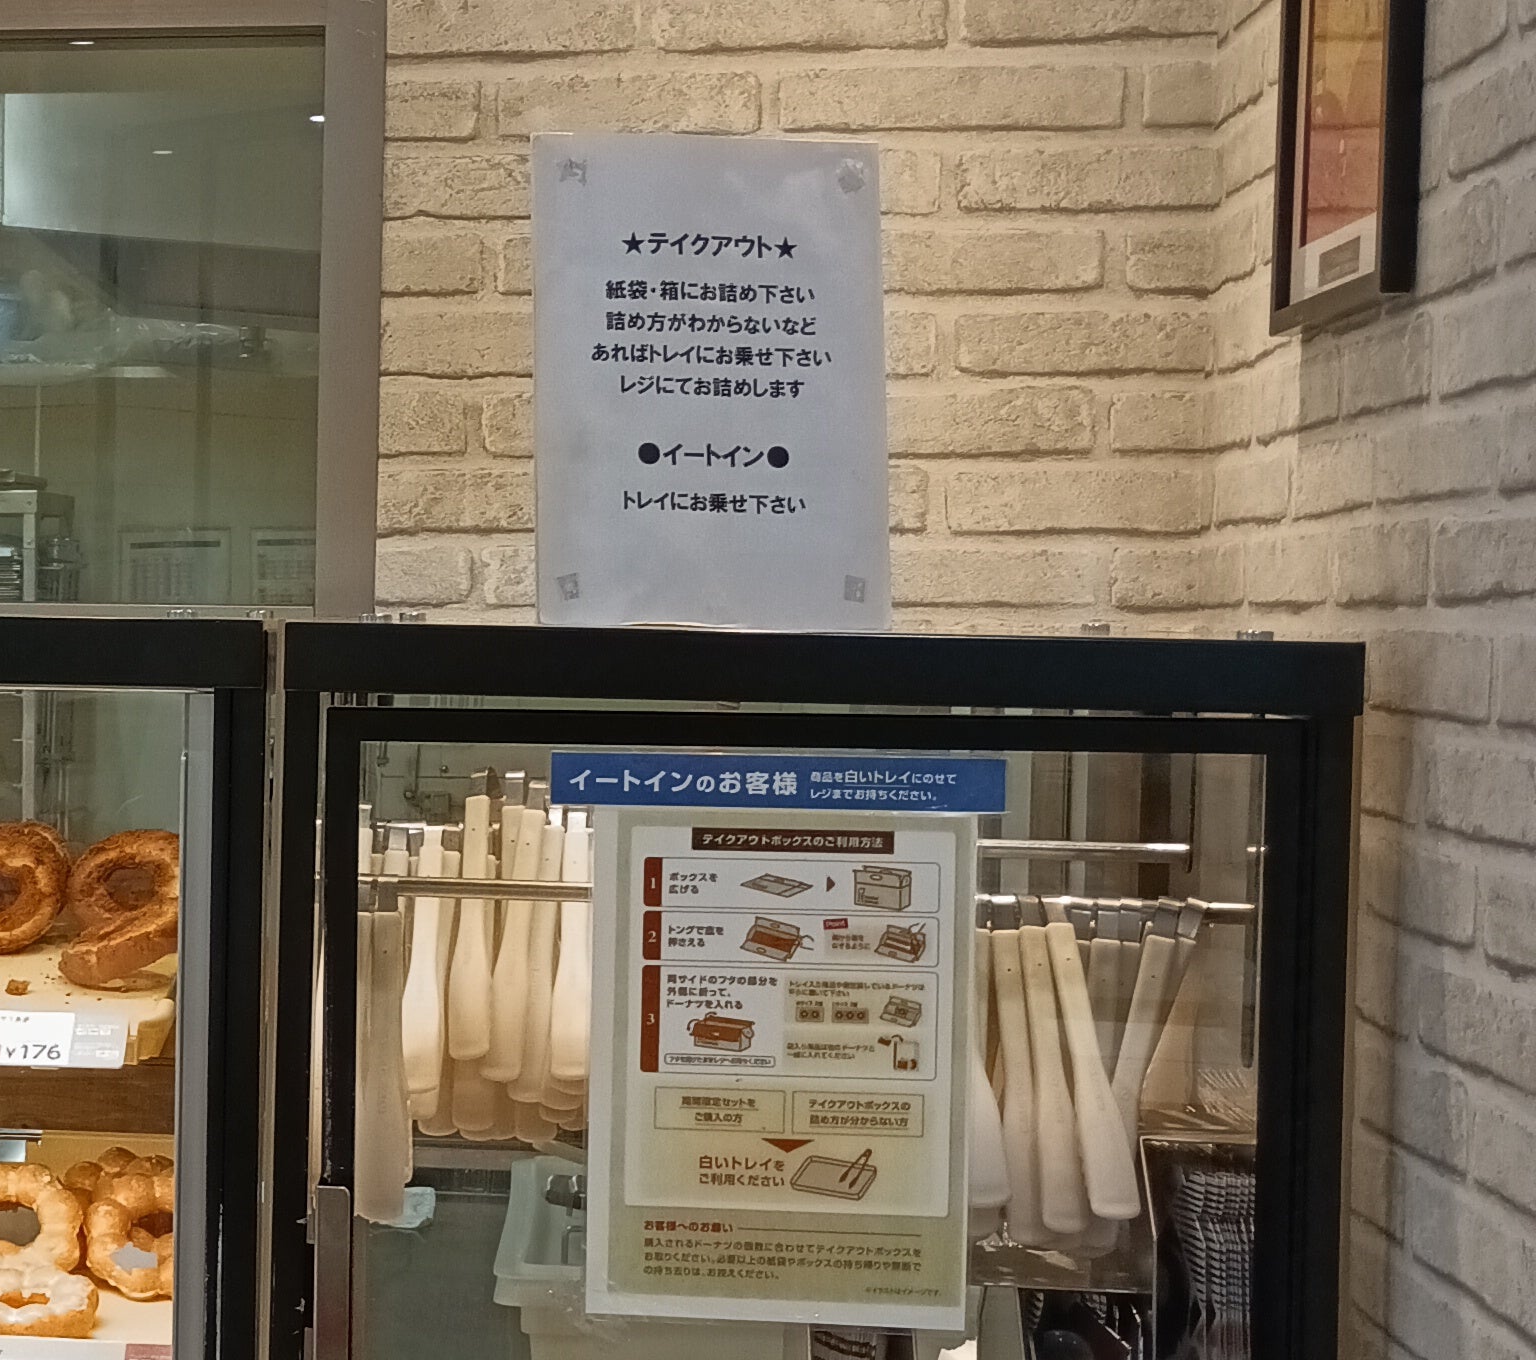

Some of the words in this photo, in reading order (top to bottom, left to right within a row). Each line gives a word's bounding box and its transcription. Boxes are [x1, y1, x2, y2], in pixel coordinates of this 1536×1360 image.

[605, 280, 816, 305] 紙袋・箱にお詰め下さい
[606, 312, 817, 336] 詰め方がわからないなど
[590, 343, 832, 368] あればトレイにお乗せ下さい
[620, 375, 806, 400] レジにてお詰めします
[622, 490, 807, 515] トレイにお乗せ下さい
[568, 769, 799, 797] イートインのお客様
[810, 769, 957, 787] 商品を白いトレイにのせて
[810, 787, 938, 802] レジまでお持ちください。
[701, 833, 884, 850] テイクアウトボックスのご利用方法
[649, 877, 657, 890] 1
[669, 872, 718, 883] ボックスを
[668, 884, 700, 895] 広げる
[647, 930, 658, 944] 2
[666, 999, 744, 1010] ドーナツを入れる
[646, 1013, 656, 1027] 3
[808, 1098, 912, 1112] テイクアウトボックスの
[698, 1155, 785, 1172] 白いトレイを
[698, 1173, 785, 1188] ご利用ください
[643, 1220, 734, 1234] お客様へのお願い
